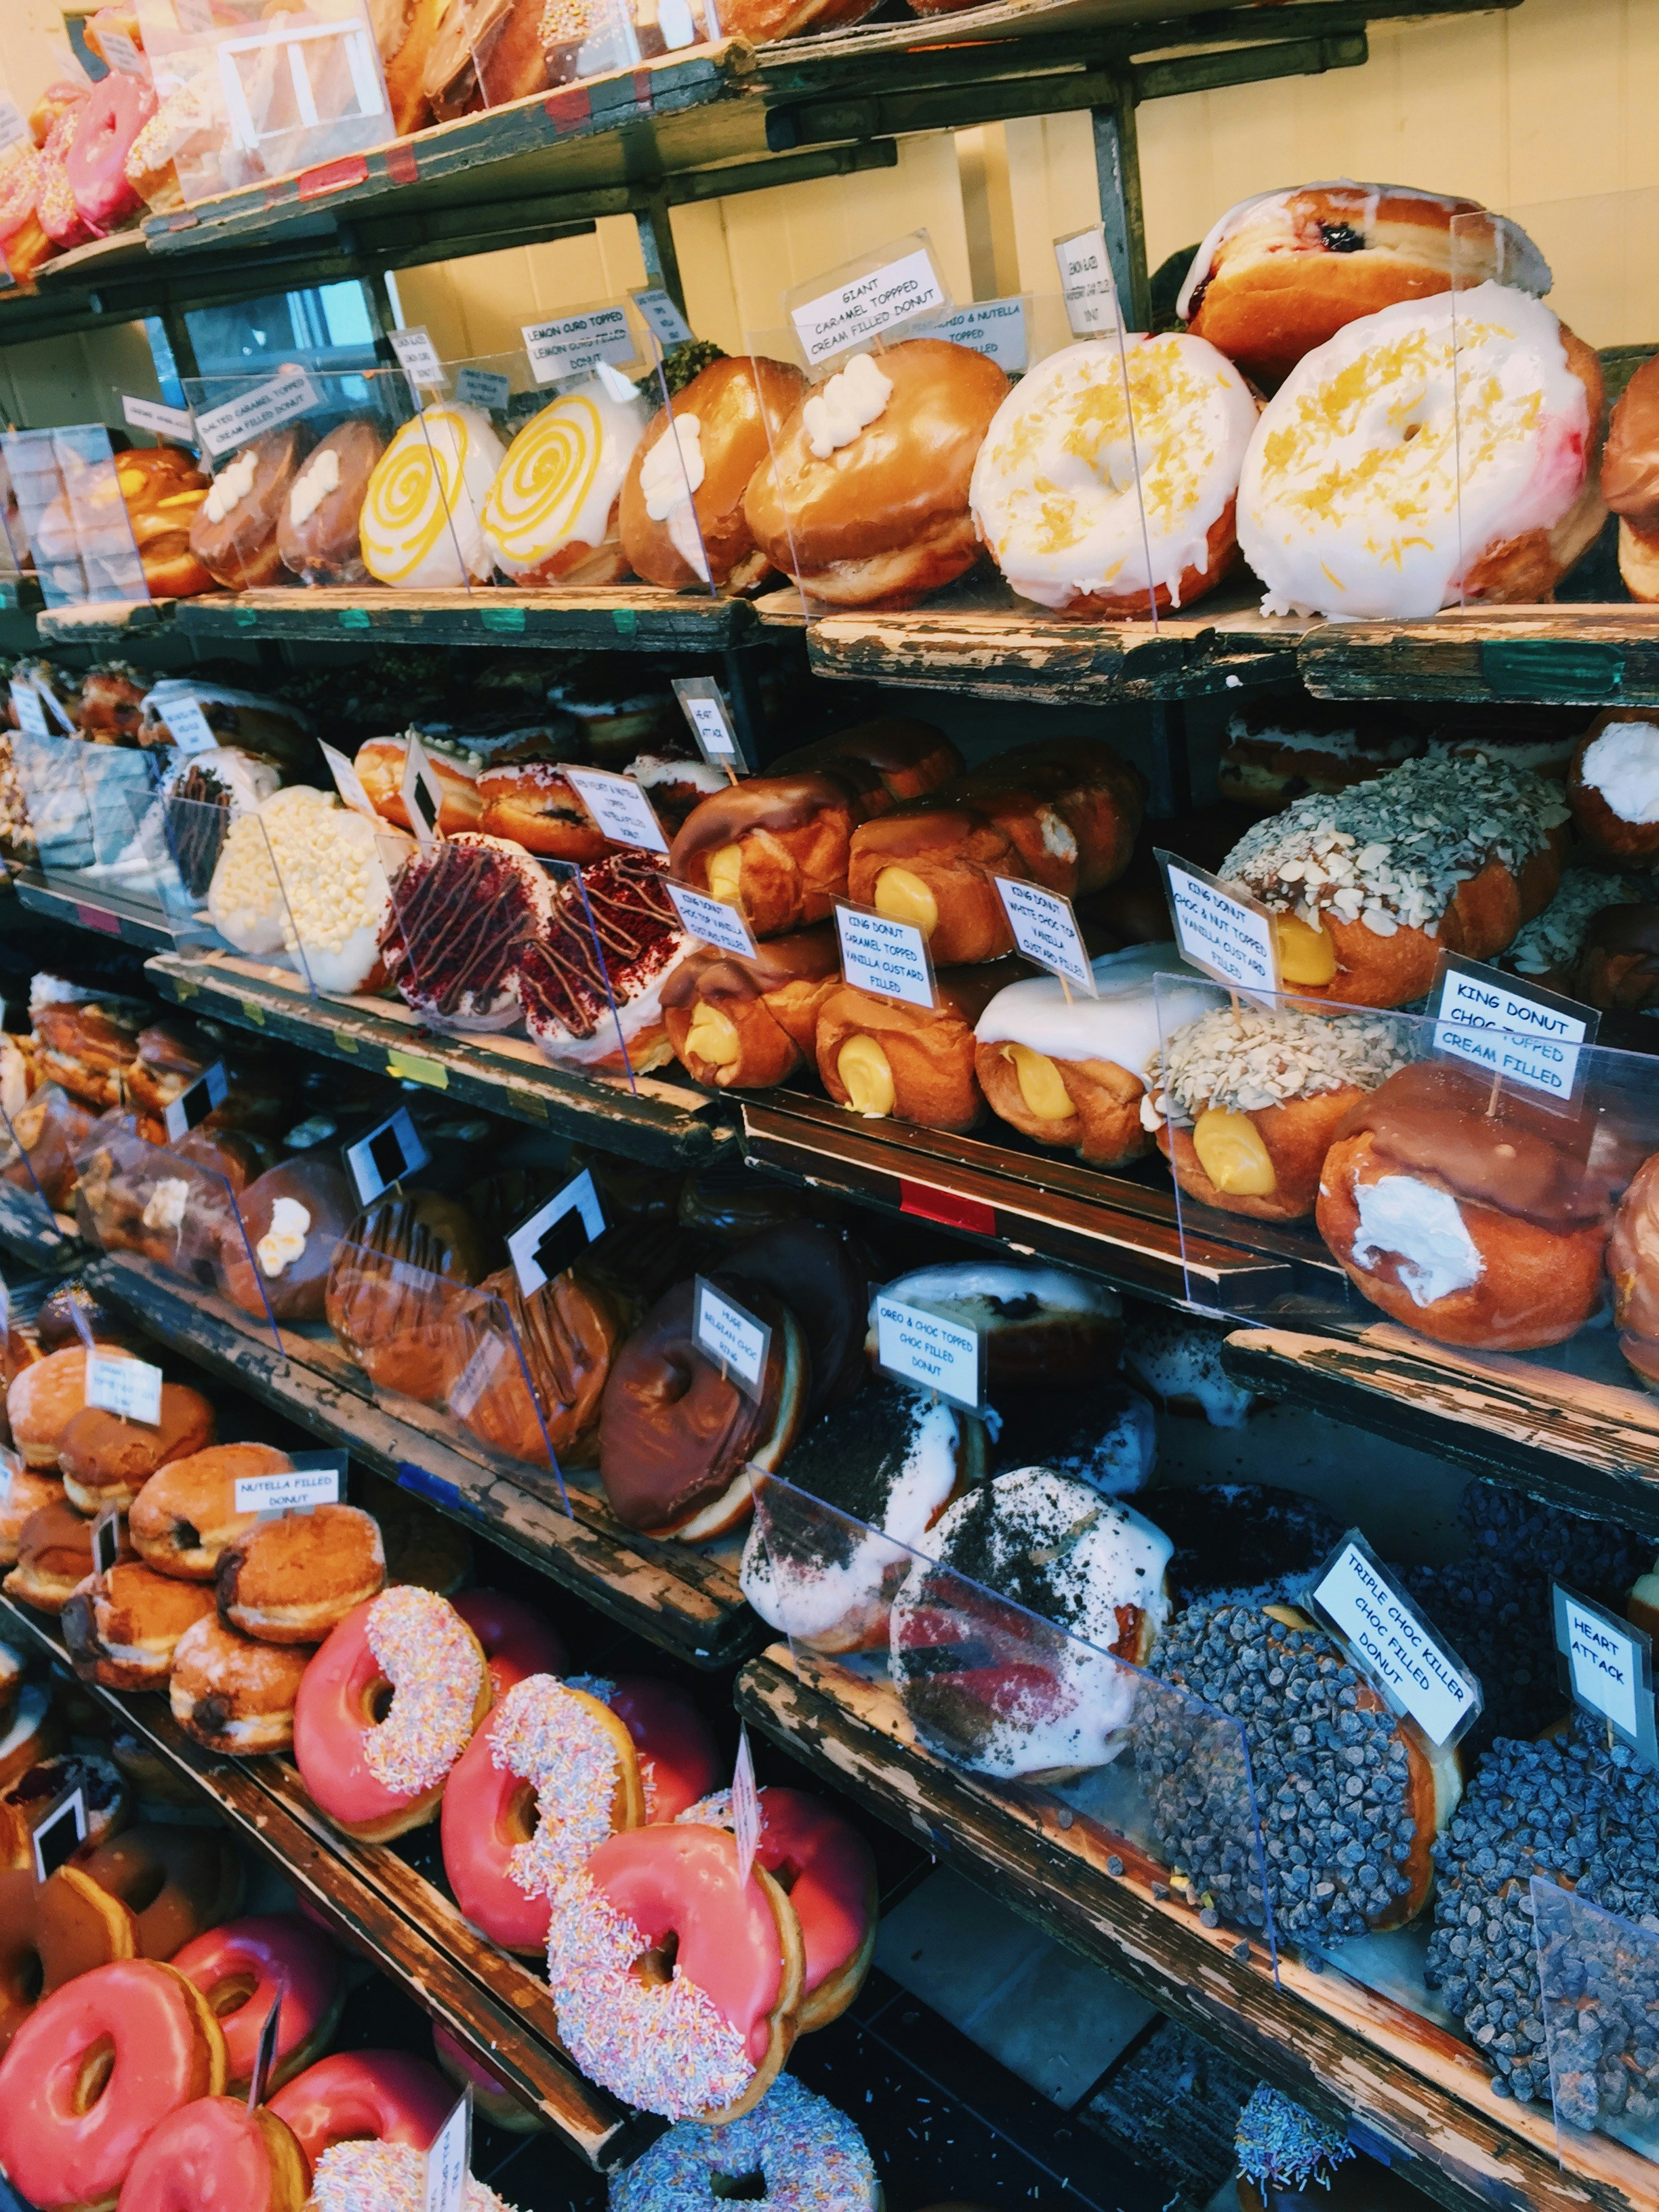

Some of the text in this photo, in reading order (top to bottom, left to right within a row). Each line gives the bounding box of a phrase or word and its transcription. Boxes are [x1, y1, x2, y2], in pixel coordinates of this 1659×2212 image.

[815, 280, 918, 334] CARAMEL TOPPPED
[842, 278, 878, 304] GIANT
[528, 312, 623, 342] LEMON CURD TOPPED
[811, 331, 849, 354] CREAM
[851, 311, 890, 337] FILLED
[894, 289, 934, 316] DONUT
[977, 305, 1020, 321] NUTELLA
[534, 346, 567, 360] LEMON
[949, 329, 985, 343] TOPPED
[1187, 880, 1246, 923] KING DONUT
[872, 922, 903, 938] DONUT
[1173, 893, 1198, 913] CHOC
[1210, 914, 1229, 933] NUT
[1231, 926, 1267, 957] TOPPED
[845, 932, 917, 961] CARAMEL TOPPED
[1181, 914, 1265, 976] VANILLA CUSTARD
[845, 949, 924, 981] VANILLA CUSTARD
[1211, 951, 1242, 979] FILLED
[869, 975, 901, 993] FILLED
[1457, 983, 1569, 1035] KING DONUT
[1451, 1008, 1563, 1063] CHOC TOPPED
[1442, 1032, 1562, 1088] CREAM FILLED
[880, 1307, 972, 1352] OREO & CHOC TOPPED
[899, 1333, 954, 1364] CHOC FILLED
[912, 1356, 942, 1376] DONUT
[241, 1476, 331, 1492] NUTELLA FILLED
[269, 1494, 308, 1506] DONUT
[1348, 1553, 1465, 1702] TRIPLE CHOC KILLER
[1355, 1597, 1429, 1690] CHOC FILLED
[1574, 1617, 1619, 1656] HEART
[1359, 1632, 1404, 1685] DONUT
[1572, 1641, 1625, 1685] ATTACK
